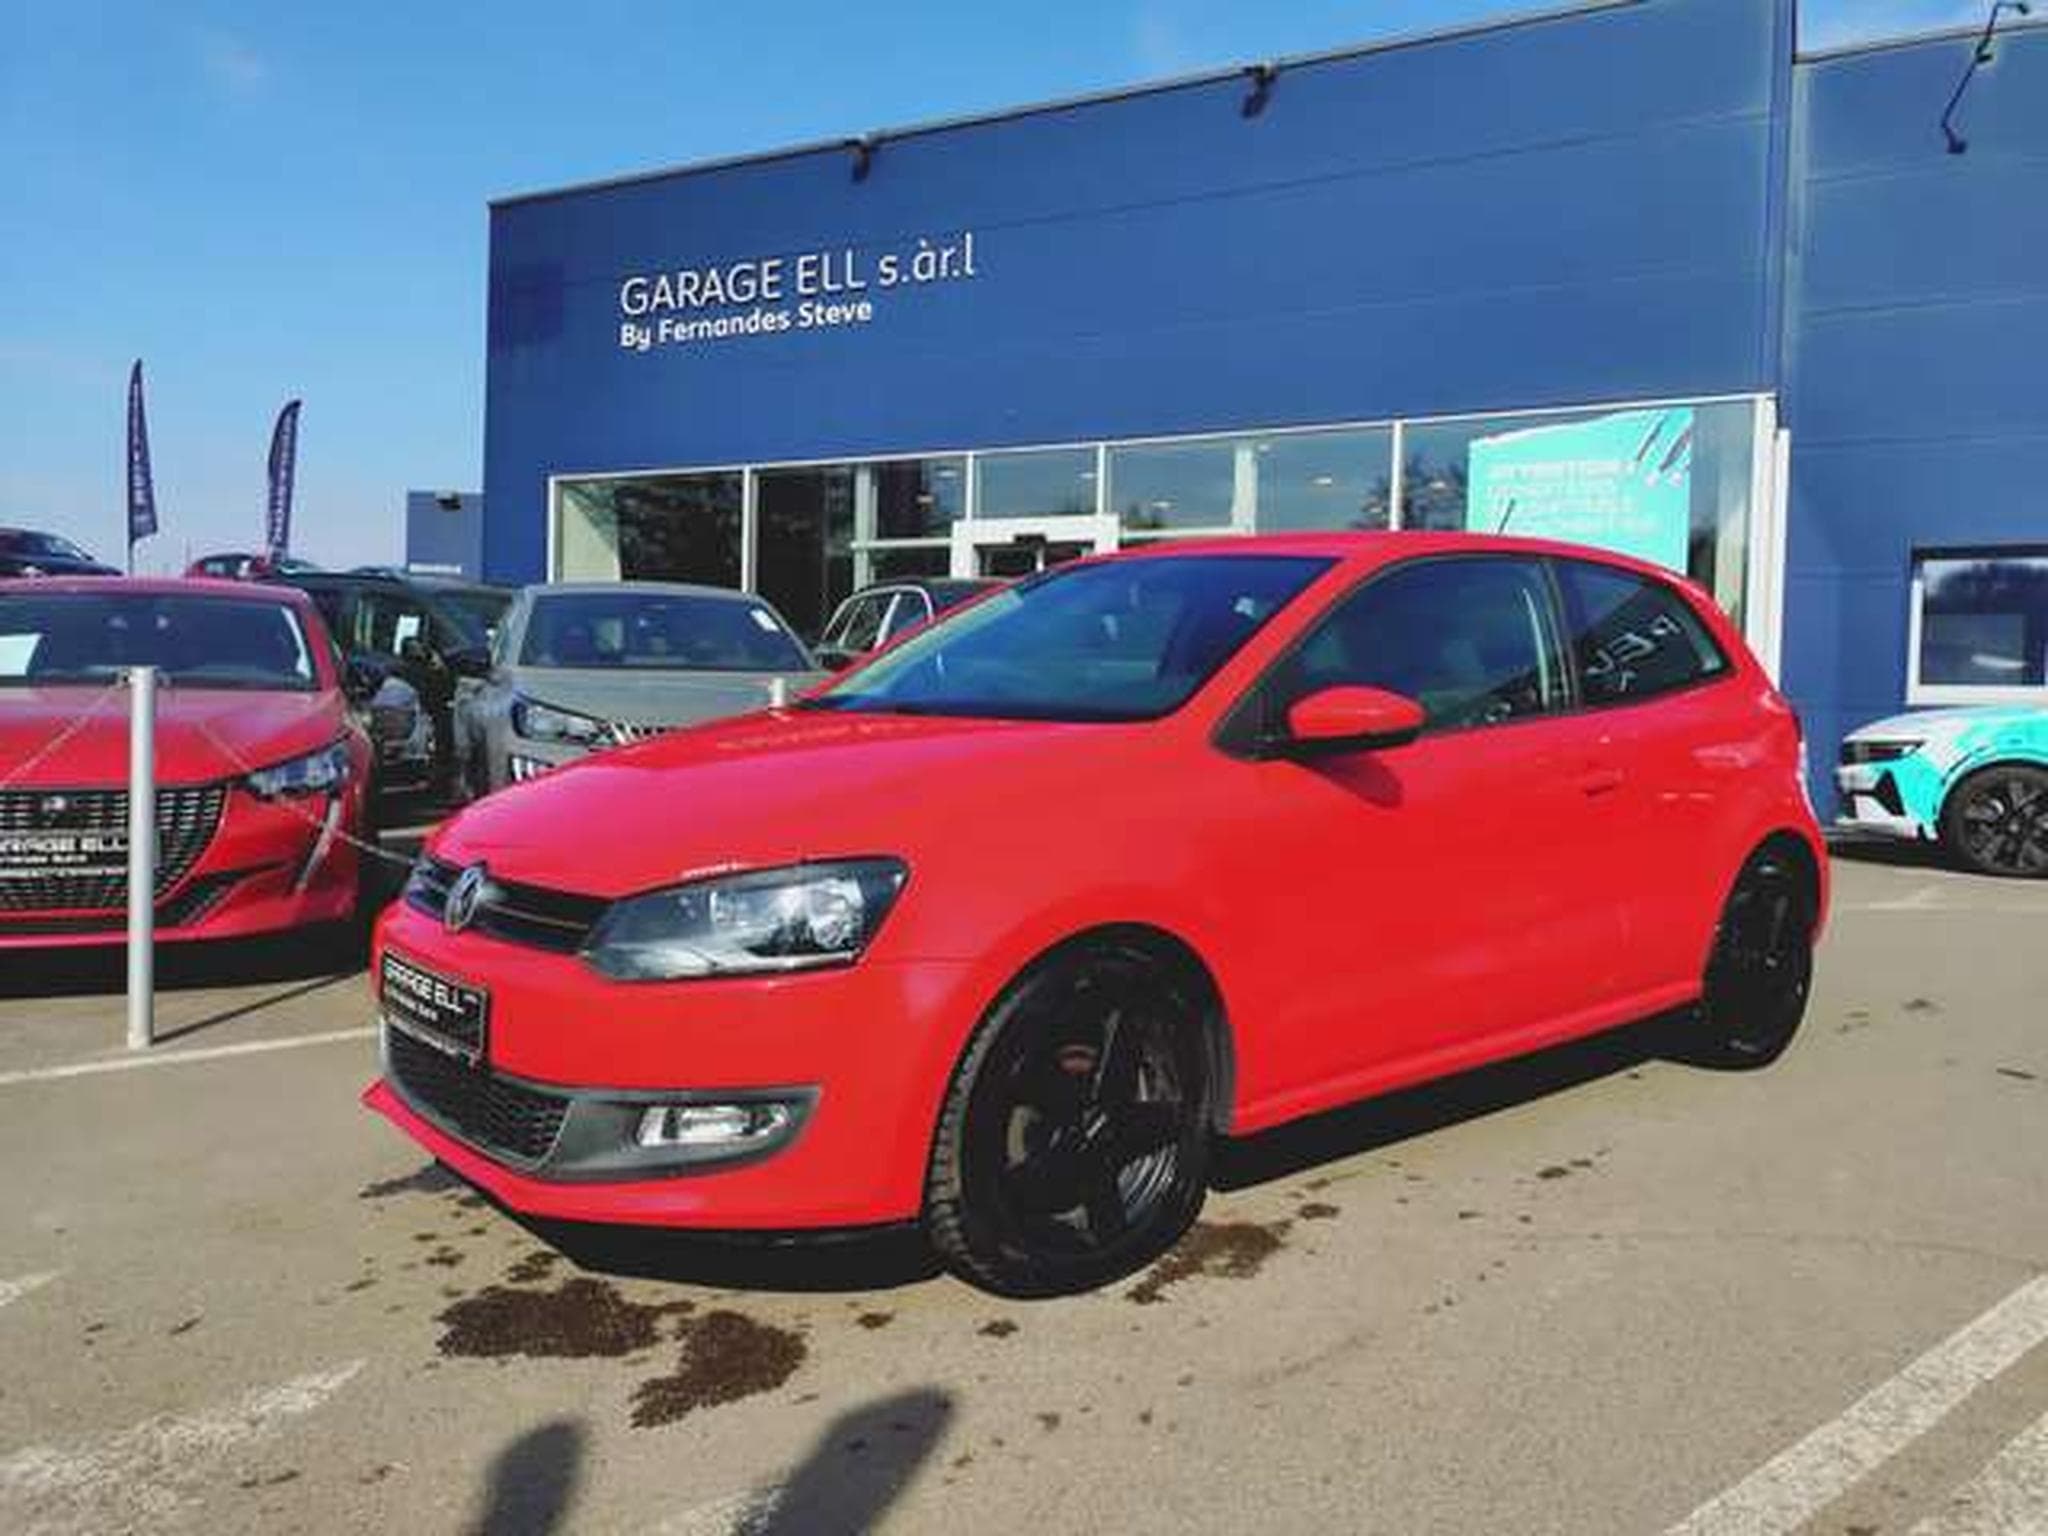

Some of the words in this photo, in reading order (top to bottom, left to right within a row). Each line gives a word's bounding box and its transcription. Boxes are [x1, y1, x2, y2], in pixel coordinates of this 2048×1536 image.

[620, 258, 782, 315] GARAGE
[797, 249, 867, 295] ELL
[619, 322, 652, 351] By
[658, 308, 791, 344] Fernandes
[798, 300, 872, 327] Steve
